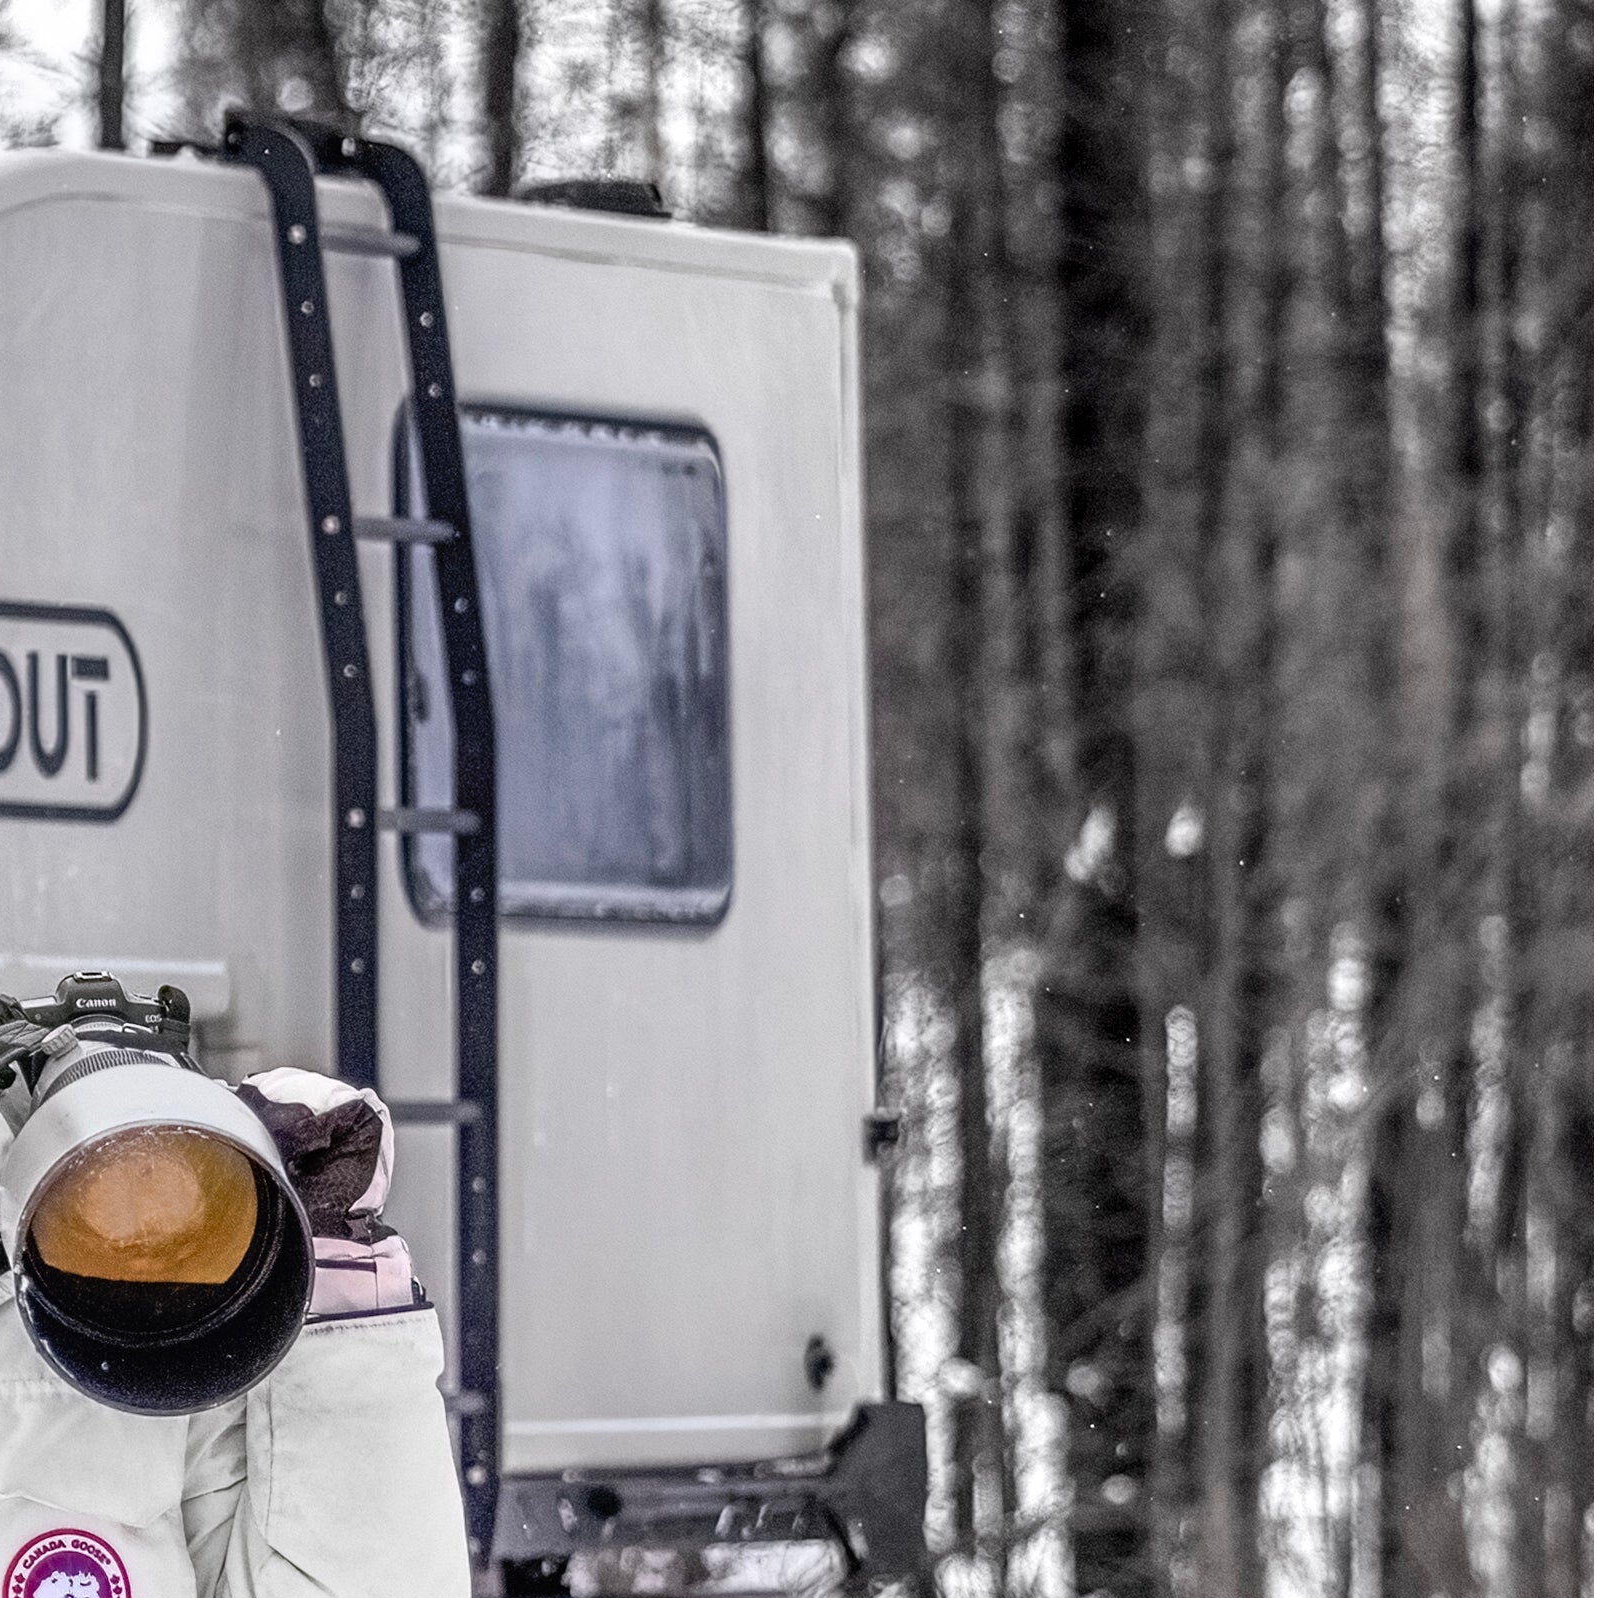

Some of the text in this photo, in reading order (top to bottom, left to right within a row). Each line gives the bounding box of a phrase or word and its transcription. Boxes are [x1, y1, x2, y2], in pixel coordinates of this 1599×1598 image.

[75, 997, 117, 1009] Canon
[145, 1014, 163, 1024] EOS
[23, 1539, 108, 1569] CANADA GOOSE
